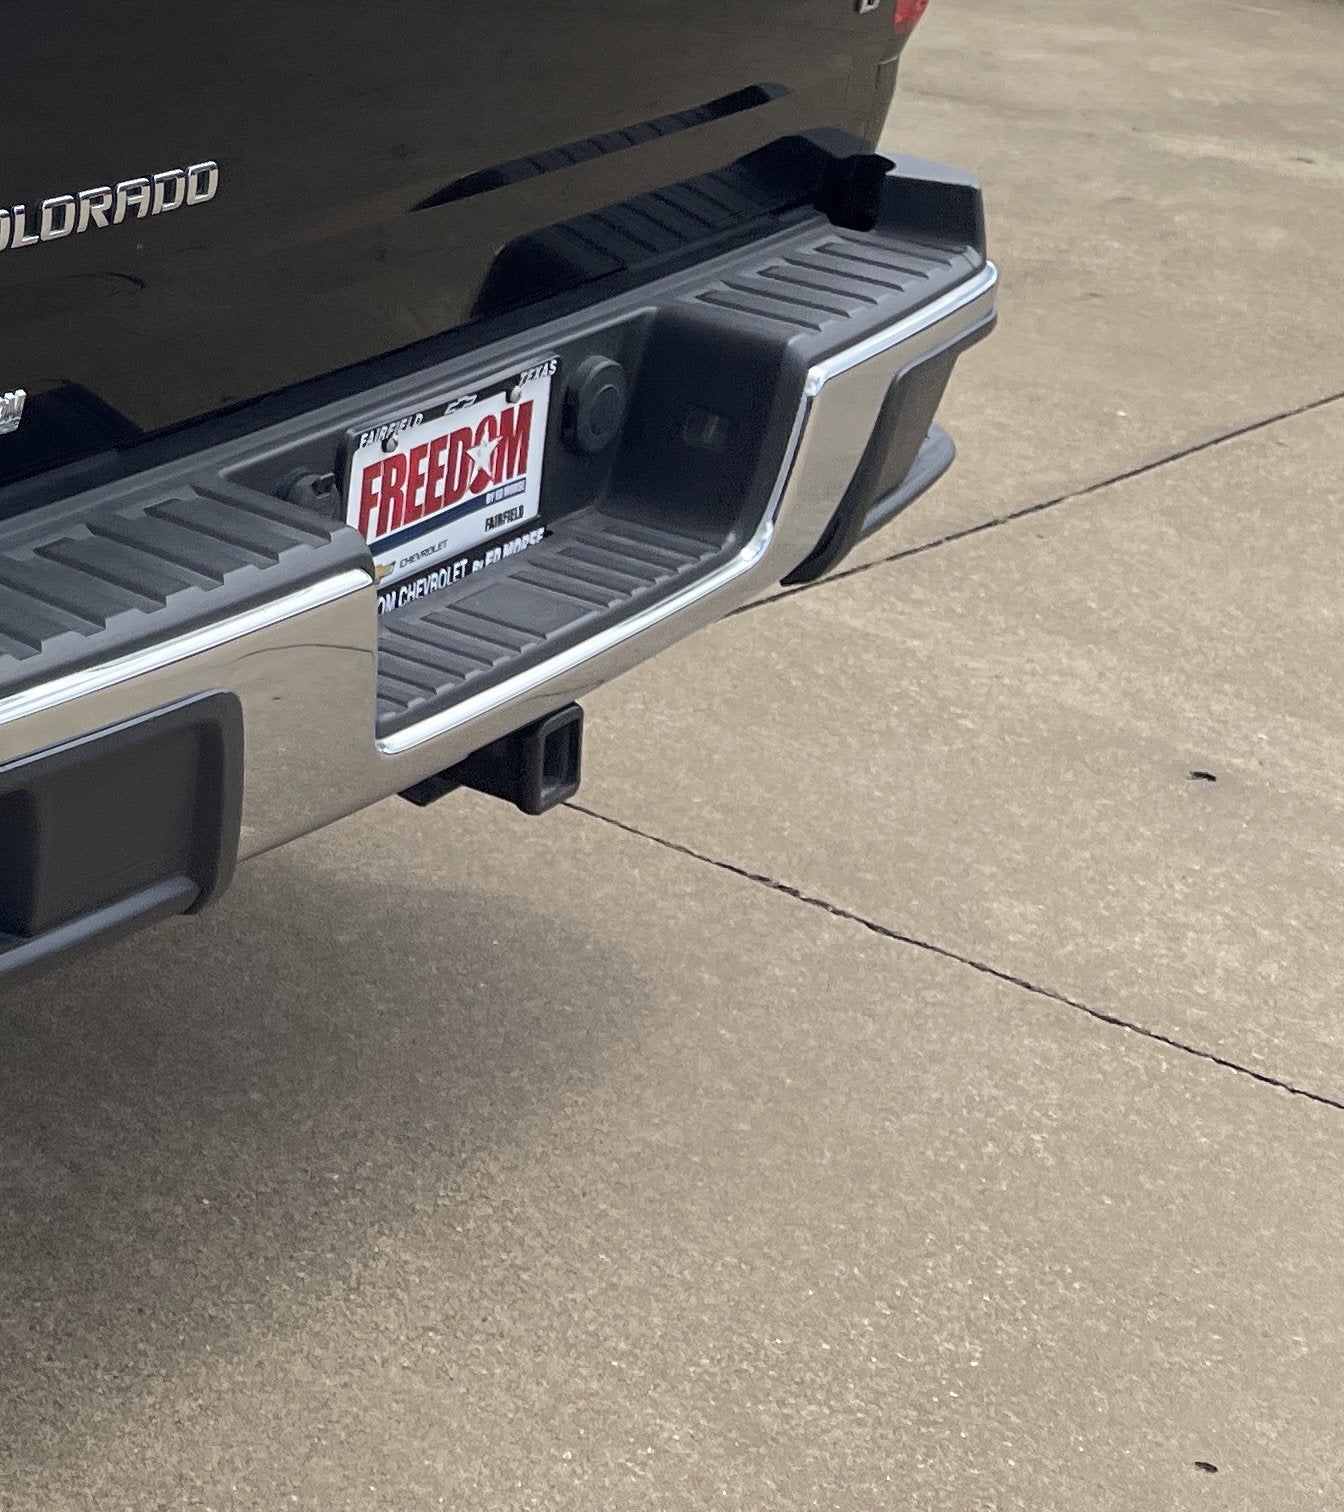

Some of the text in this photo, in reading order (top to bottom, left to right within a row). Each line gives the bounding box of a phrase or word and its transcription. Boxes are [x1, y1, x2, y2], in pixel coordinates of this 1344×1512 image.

[358, 359, 558, 450] FAIRFIELD TEXAS
[358, 399, 535, 542] FREEDOM
[484, 504, 525, 533] FAIRFIELD
[399, 539, 449, 568] CHEVROLET
[398, 558, 469, 608] CHEVROLET
